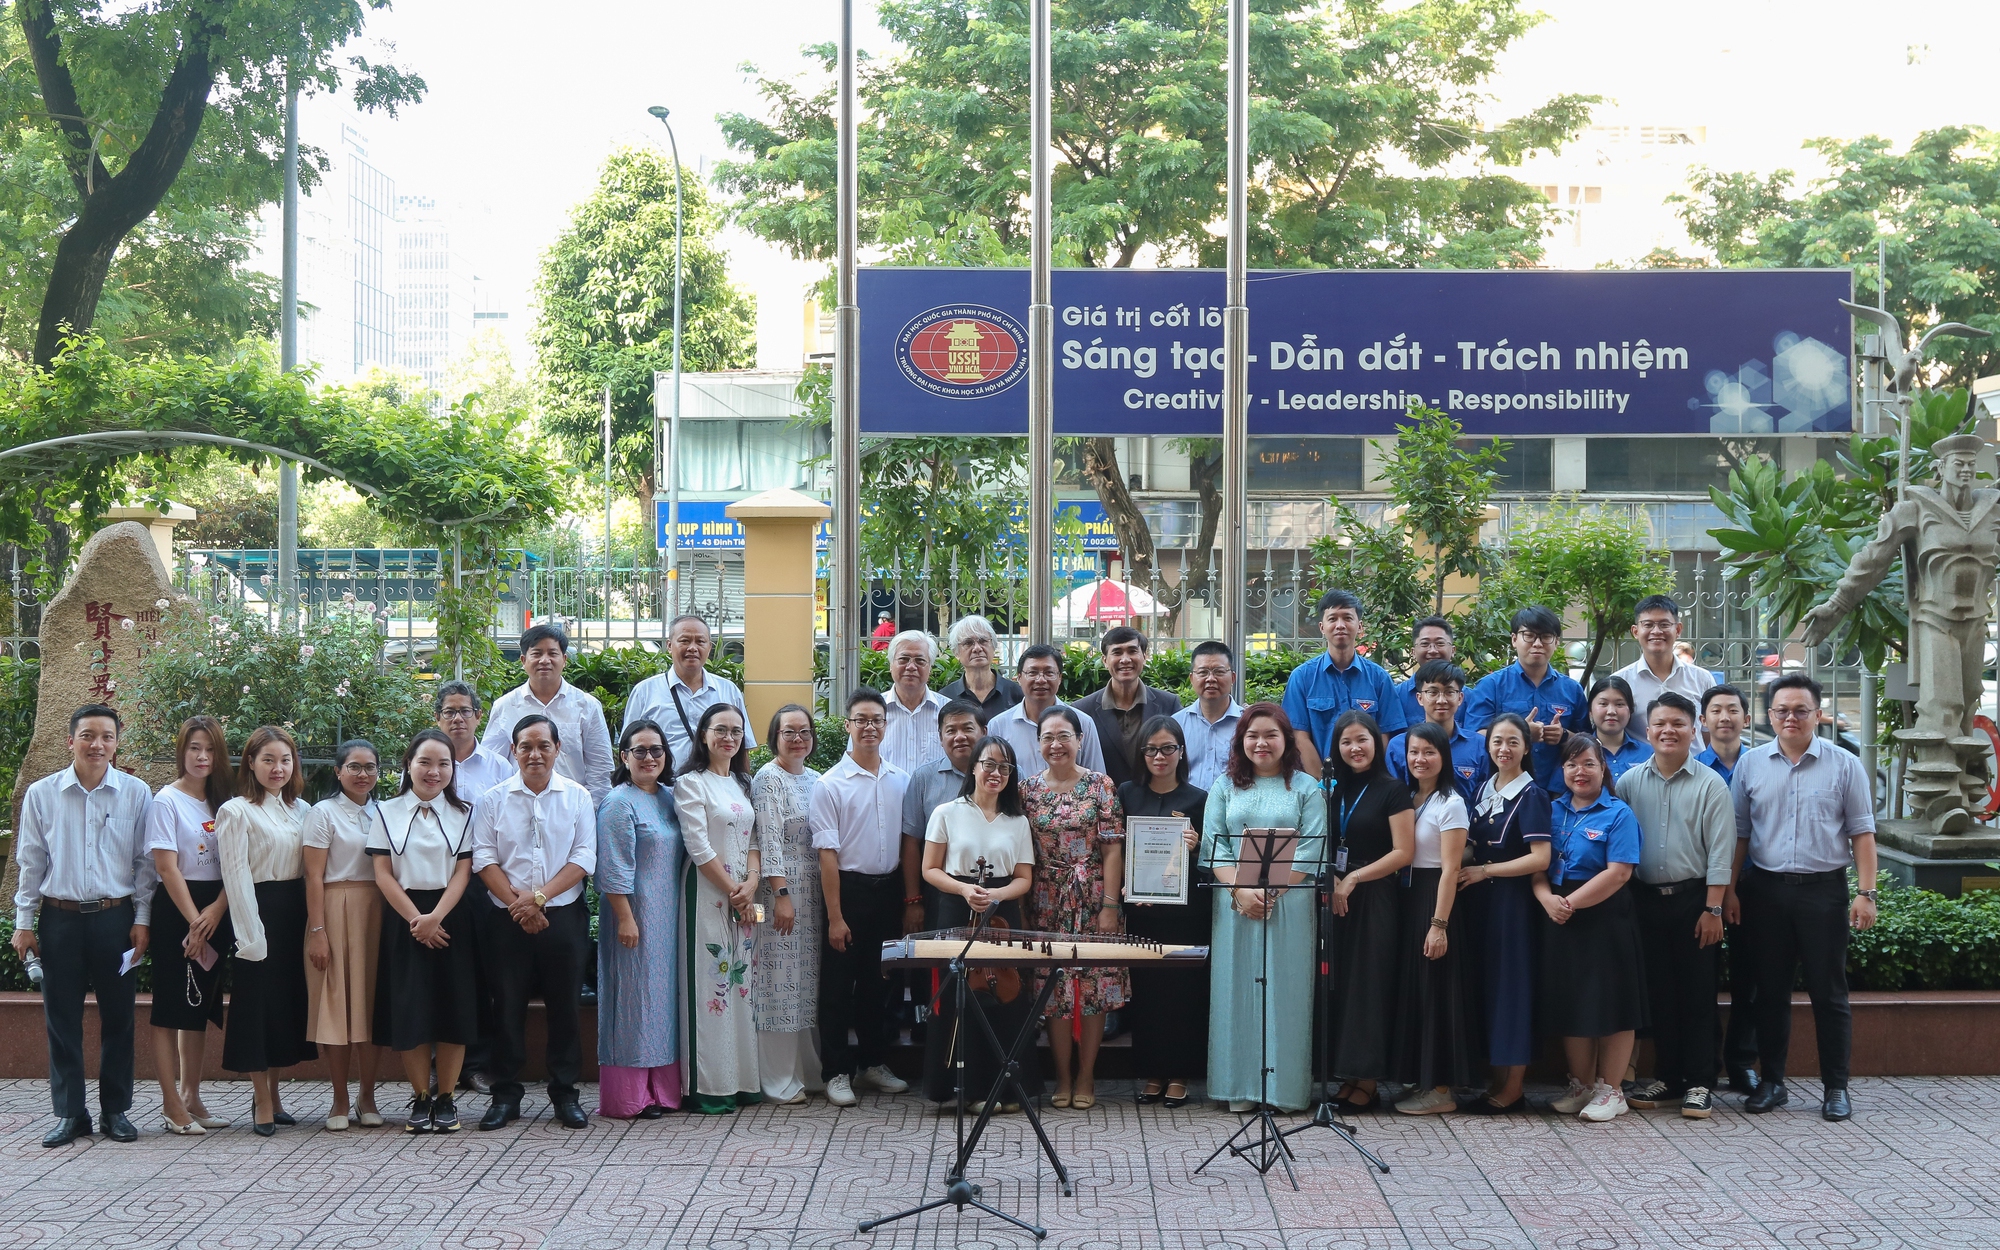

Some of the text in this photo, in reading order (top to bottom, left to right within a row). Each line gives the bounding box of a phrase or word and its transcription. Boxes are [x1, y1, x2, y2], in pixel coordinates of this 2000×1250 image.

[1063, 303, 1224, 331] Giá trị cốt lõ
[902, 331, 912, 343] ĐẠI
[910, 321, 923, 332] HỌC
[922, 312, 940, 324] QUỐC
[1002, 320, 1014, 330] CHÍ
[1012, 328, 1025, 344] MINH
[948, 352, 980, 364] USSH
[1063, 337, 1156, 378] Sáng
[1271, 334, 1343, 370] Dẫn
[1359, 333, 1422, 370] dắt
[1458, 339, 1560, 370] Trách
[1576, 339, 1688, 378] nhiệm
[900, 356, 917, 380] TRƯỜNG
[916, 376, 928, 386] ĐẠI
[928, 382, 942, 392] HỌC
[984, 384, 996, 392] HỘI
[996, 380, 1005, 388] VÀ
[1005, 368, 1020, 384] NHÂN
[1278, 389, 1423, 413] Leadership
[1449, 390, 1630, 414] Responsibility
[702, 520, 732, 535] HÌNH
[769, 942, 798, 952] USSH
[760, 961, 782, 970] SSH
[772, 1016, 799, 1026] USSH
